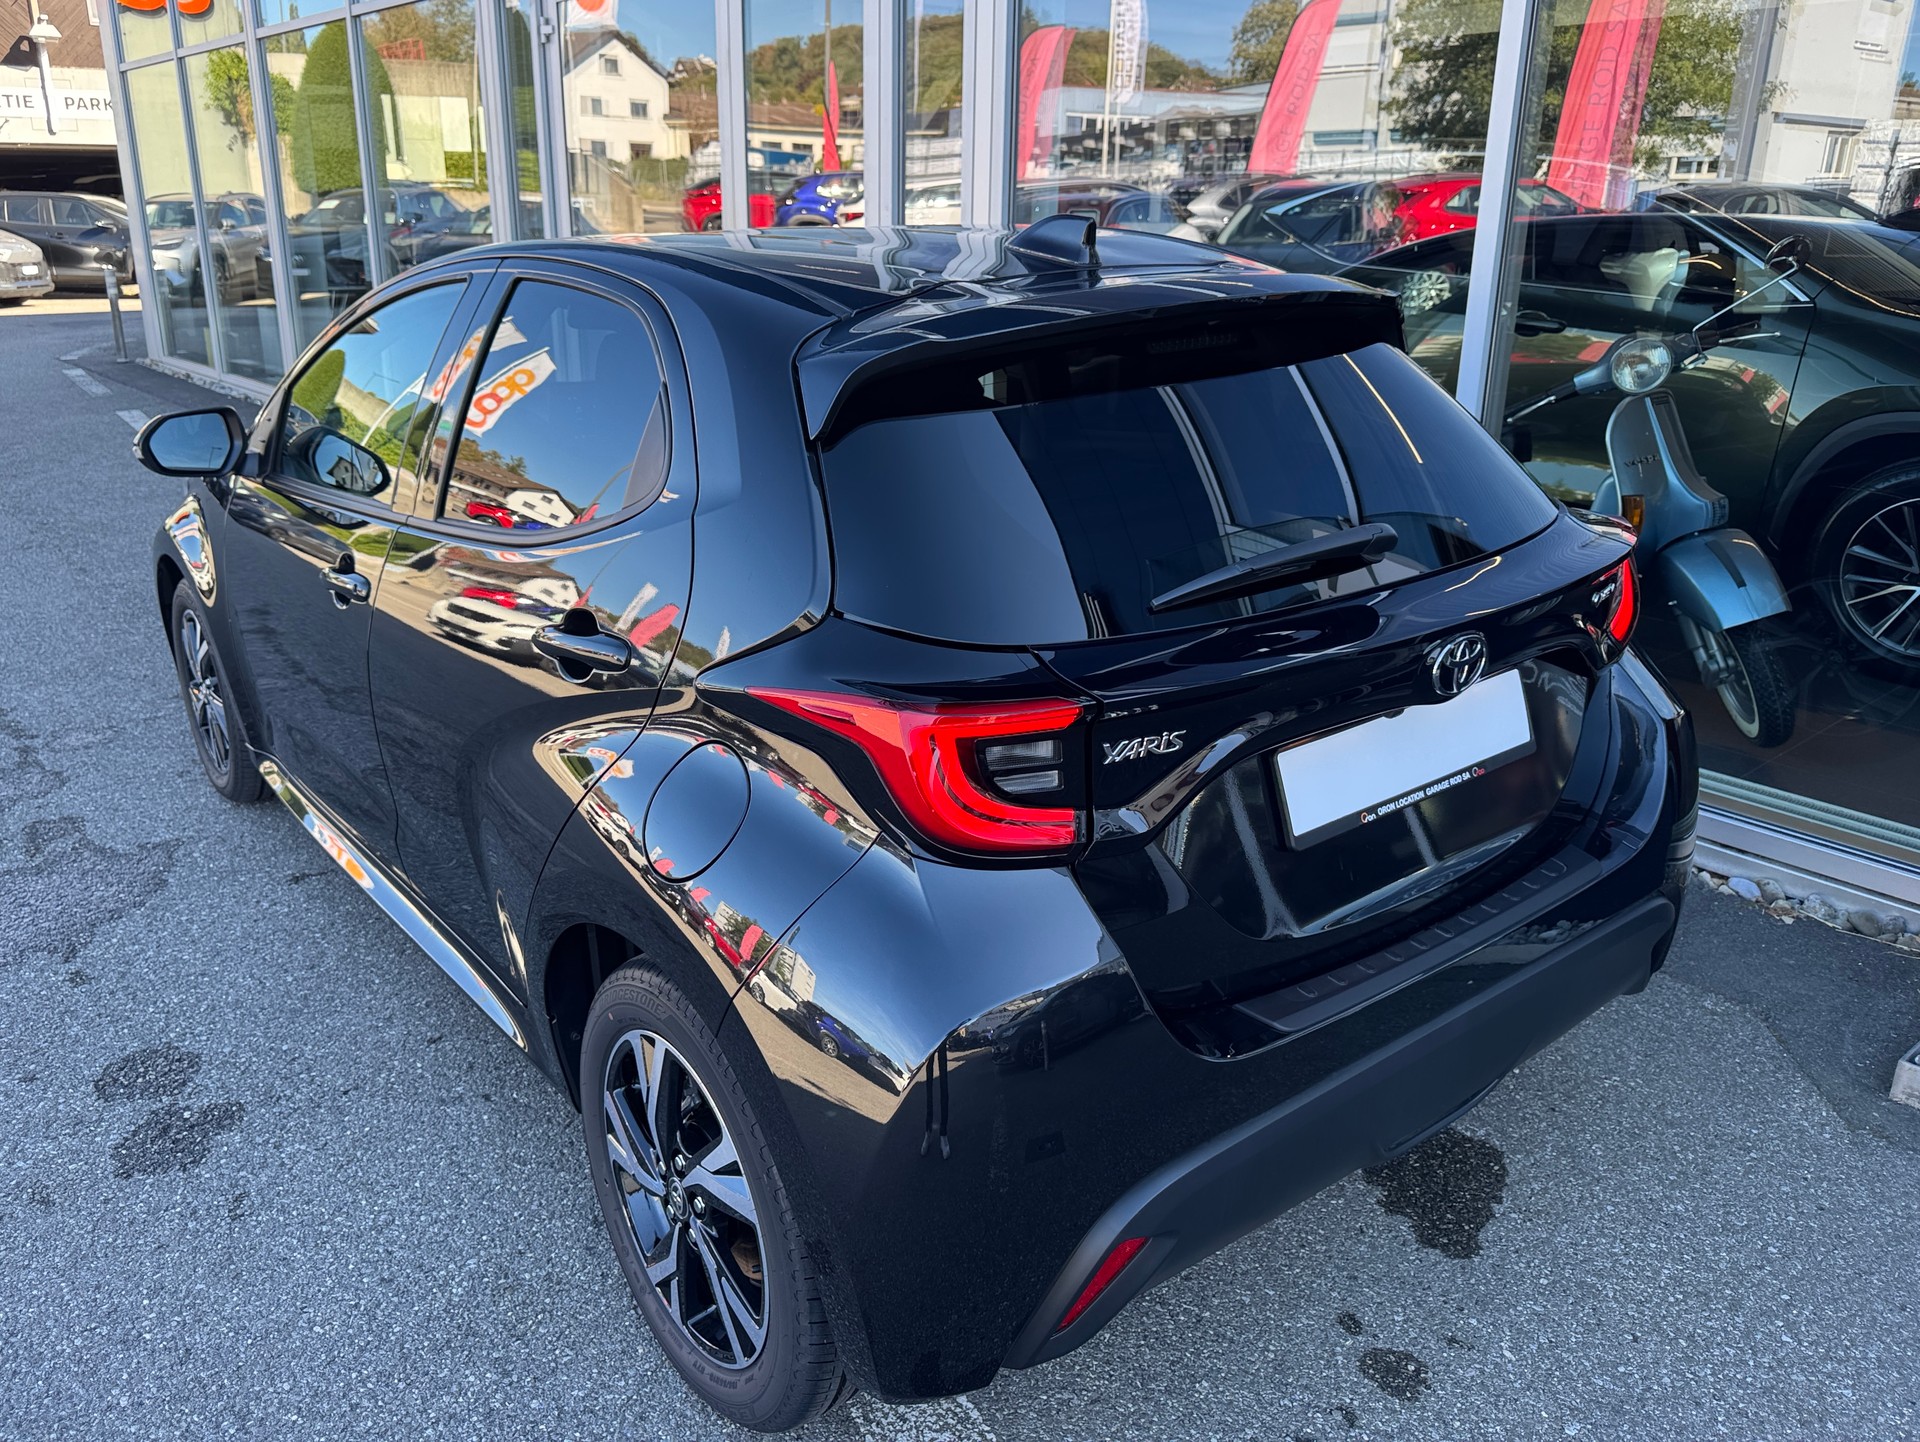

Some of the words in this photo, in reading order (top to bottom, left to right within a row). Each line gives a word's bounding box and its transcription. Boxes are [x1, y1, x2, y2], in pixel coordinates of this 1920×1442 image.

[1587, 46, 1619, 107] ROD
[0, 94, 34, 109] TIE
[1378, 803, 1395, 816] ORON
[1395, 790, 1425, 808] LOCATION
[1426, 780, 1450, 796] GARAGE
[1450, 776, 1463, 786] ROD
[1462, 771, 1470, 781] SA
